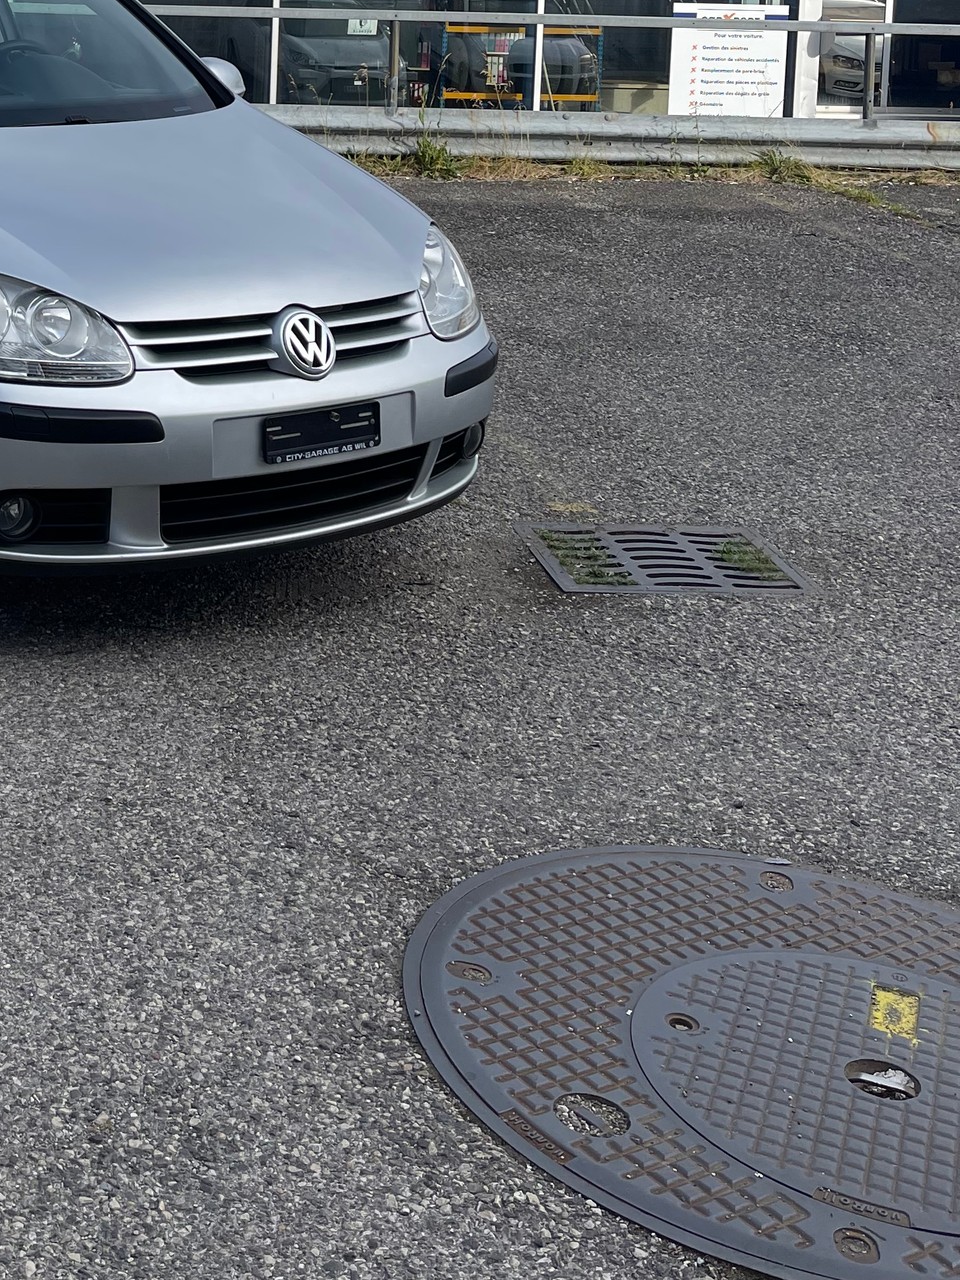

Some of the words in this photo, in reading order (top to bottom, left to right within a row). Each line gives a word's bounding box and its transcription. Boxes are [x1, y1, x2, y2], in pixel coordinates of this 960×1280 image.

[286, 447, 339, 462] CITY-GARAGE
[341, 444, 353, 452] AG
[354, 442, 366, 450] WIL
